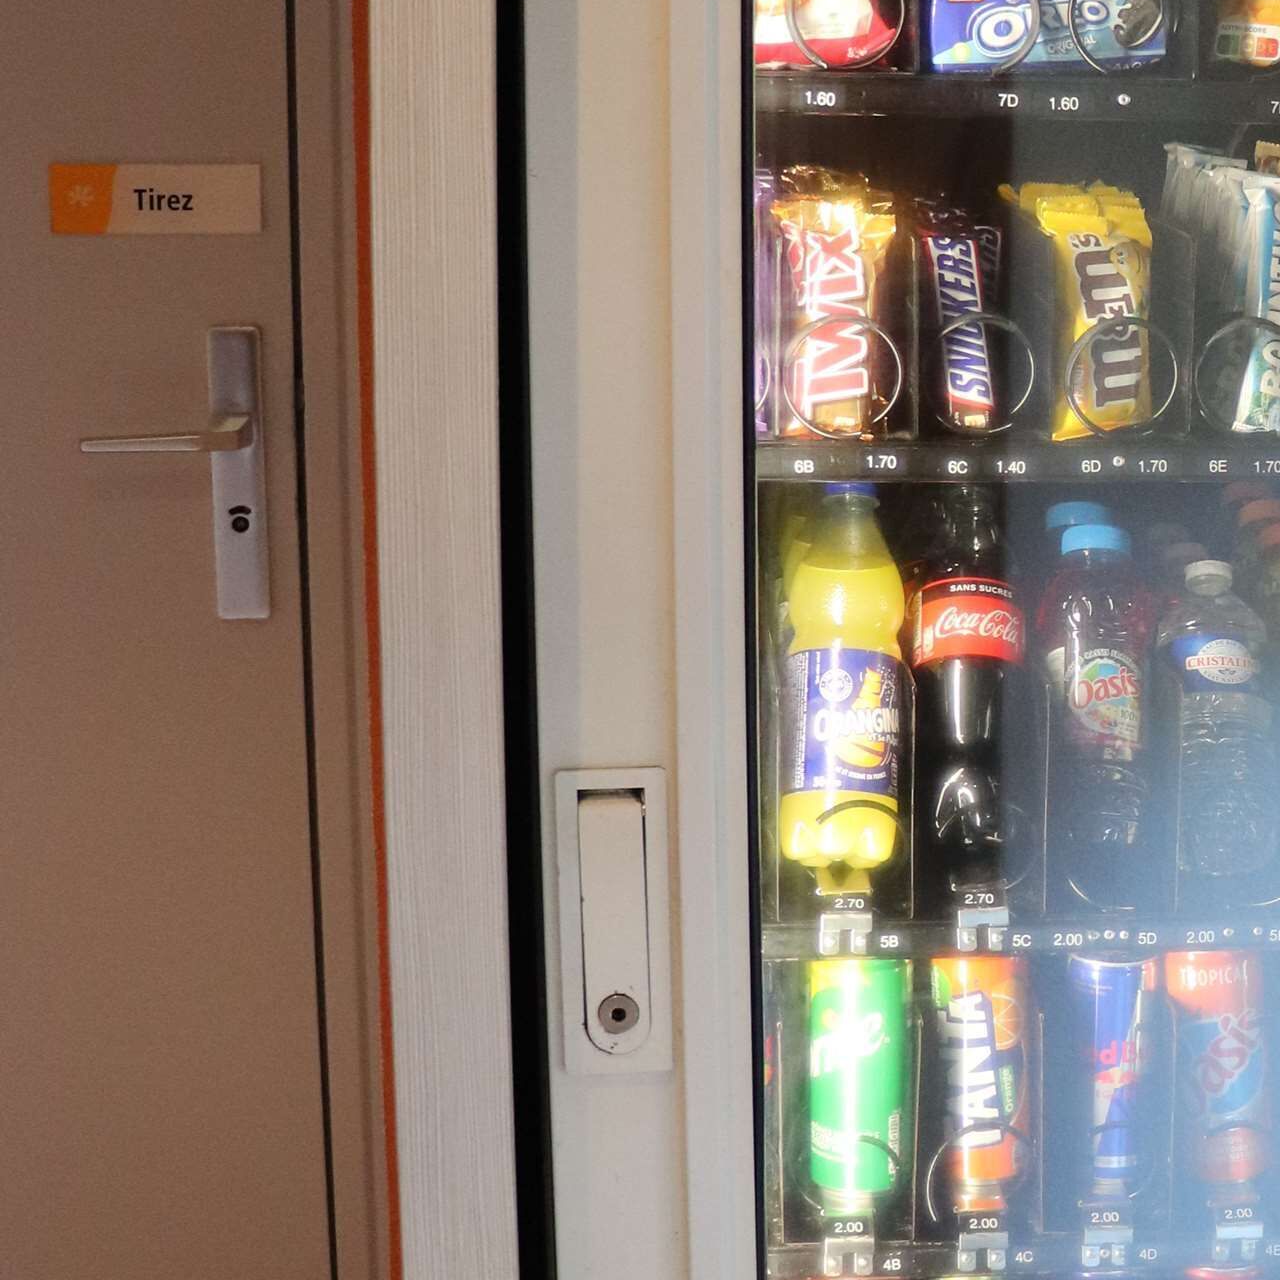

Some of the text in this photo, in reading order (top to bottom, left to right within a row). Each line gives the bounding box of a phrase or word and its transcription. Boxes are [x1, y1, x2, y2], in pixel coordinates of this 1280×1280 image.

[805, 90, 836, 107] 1.60
[998, 93, 1079, 111] 7D 1.60
[134, 188, 193, 211] Tirez
[934, 235, 991, 404] SNIKERS
[794, 455, 897, 474] 6B 1.70
[947, 460, 1026, 474] 6C 1.40
[1081, 459, 1168, 473] 6D 1.70
[1209, 459, 1227, 473] 6E
[949, 583, 1013, 598] SANS SUCRES
[1072, 666, 1140, 709] Oasis
[834, 898, 865, 909] 2.70
[964, 893, 994, 905] 2.70
[880, 935, 899, 948] 5B
[1012, 933, 1083, 947] 5C 2.00
[1137, 930, 1215, 945] 5D 2.00
[1091, 1211, 1120, 1223] 2.00
[1224, 1207, 1253, 1219] 2.00
[834, 1221, 864, 1233] 2.00
[969, 1217, 998, 1229] 2.00
[1015, 1250, 1033, 1263] 4C
[1139, 1248, 1158, 1260] 4D
[883, 1258, 902, 1271] 4B
